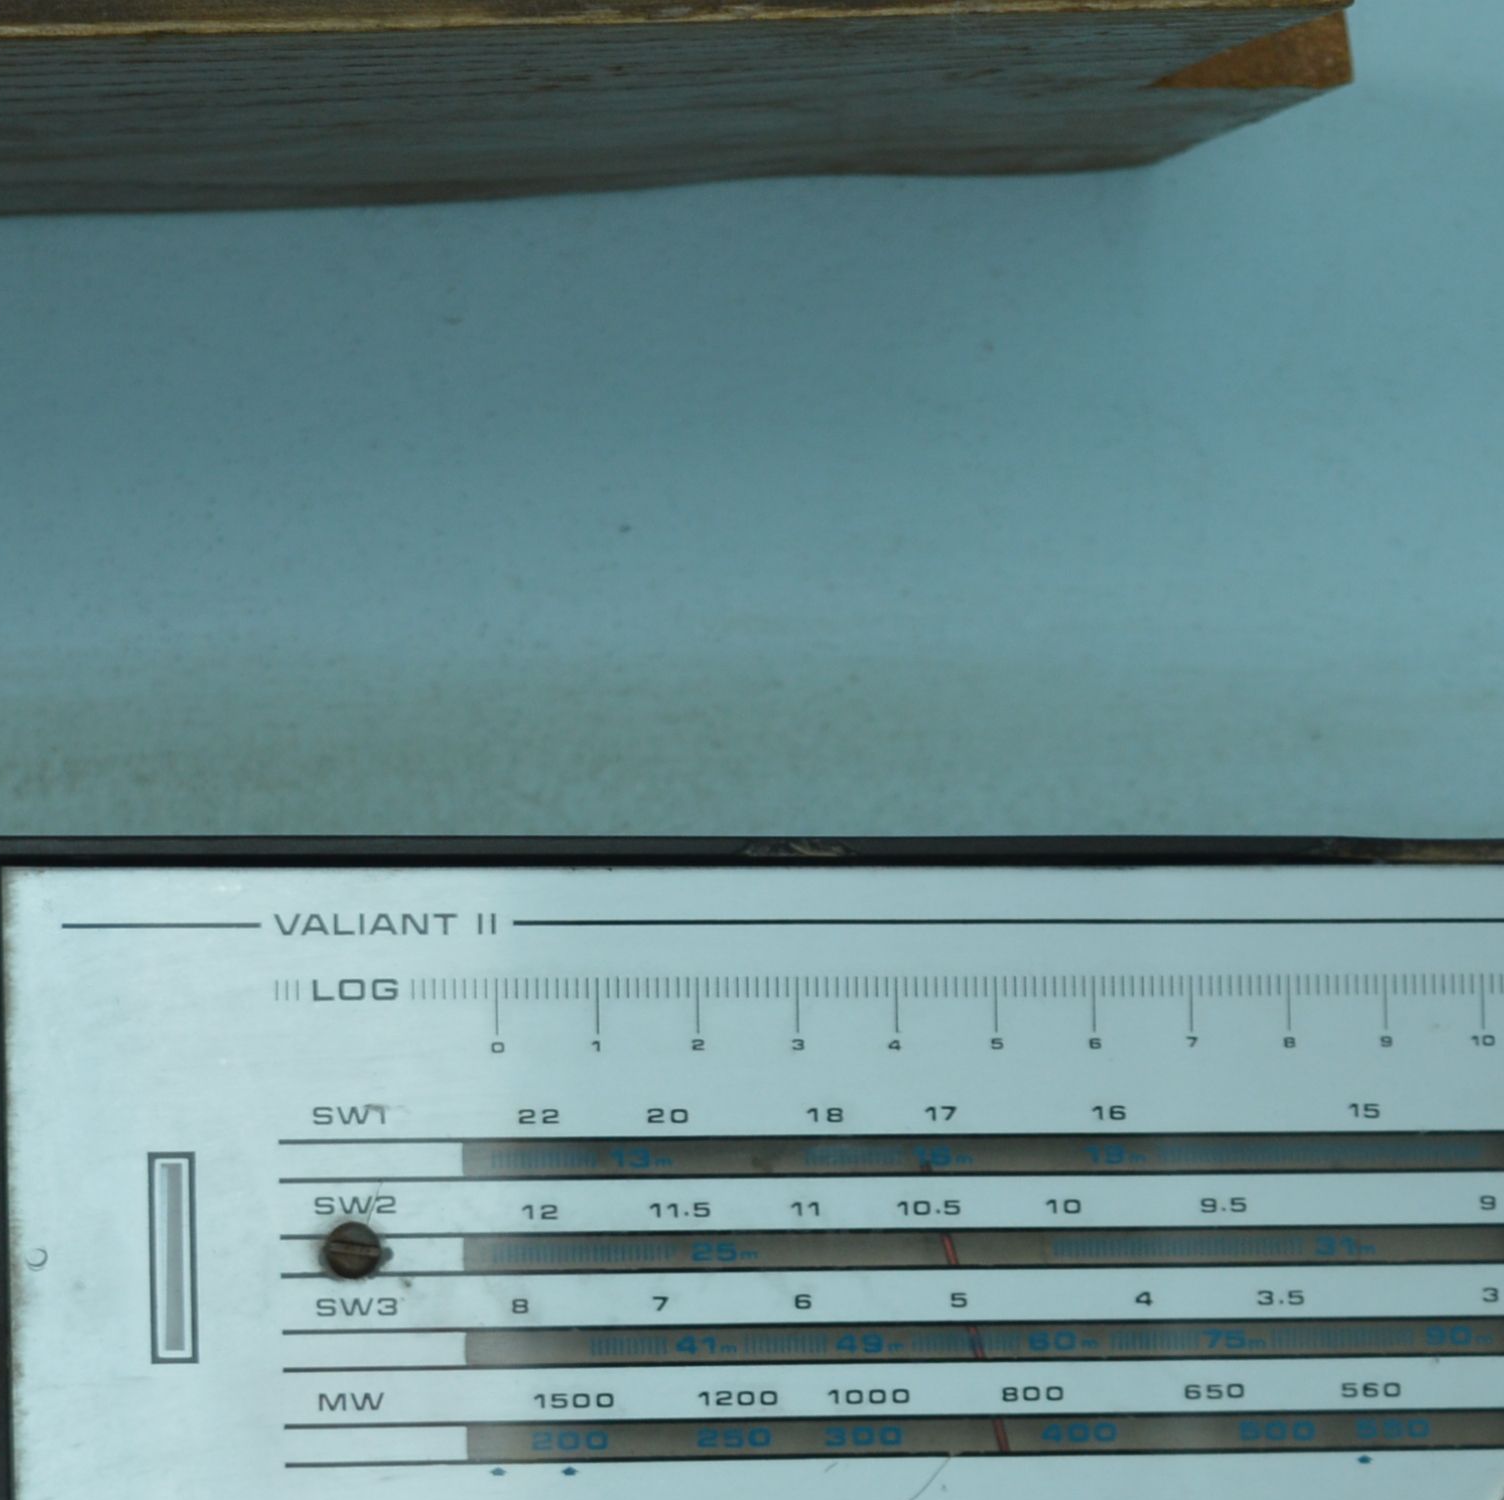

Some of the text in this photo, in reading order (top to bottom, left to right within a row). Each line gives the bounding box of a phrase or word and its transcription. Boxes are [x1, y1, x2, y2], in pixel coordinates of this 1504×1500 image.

[273, 912, 458, 937] VALIANT
[311, 978, 399, 1002] LOG
[490, 1034, 1496, 1054] 0 1 2 3 4 5 6 7 8 9 10
[311, 1104, 388, 1126] SW1
[517, 1108, 560, 1125] 22
[646, 1107, 689, 1125] 20
[806, 1107, 844, 1124] 18
[924, 1105, 958, 1122] 17
[1091, 1104, 1127, 1121] 16
[1348, 1102, 1381, 1120] 15
[313, 1194, 1497, 1221] SW2 12 11.5 11 10.5 10 9.5 9
[691, 1237, 1377, 1263] 25m 31m
[315, 1297, 398, 1318] SW3
[511, 1297, 530, 1315] 8
[652, 1295, 670, 1312] 7
[793, 1293, 812, 1310] 6
[949, 1291, 968, 1309] 5
[1134, 1290, 1153, 1307] 4
[1256, 1289, 1305, 1307] 3.5
[1482, 1286, 1500, 1304] 3
[675, 1334, 738, 1354] 41m
[1028, 1330, 1100, 1352] 60m
[1204, 1329, 1267, 1351] 75m
[1424, 1325, 1494, 1346] 90m
[317, 1392, 385, 1412] MW
[533, 1392, 615, 1410] 1500
[698, 1389, 779, 1407] 1200
[827, 1388, 911, 1406] 1000
[1001, 1385, 1064, 1403] 800
[1183, 1382, 1245, 1401] 650
[1341, 1381, 1402, 1399] 560
[531, 1431, 609, 1452] 200
[697, 1427, 772, 1448] 250
[823, 1426, 904, 1447] 300
[1041, 1422, 1118, 1443] 400
[1239, 1420, 1316, 1442] 500
